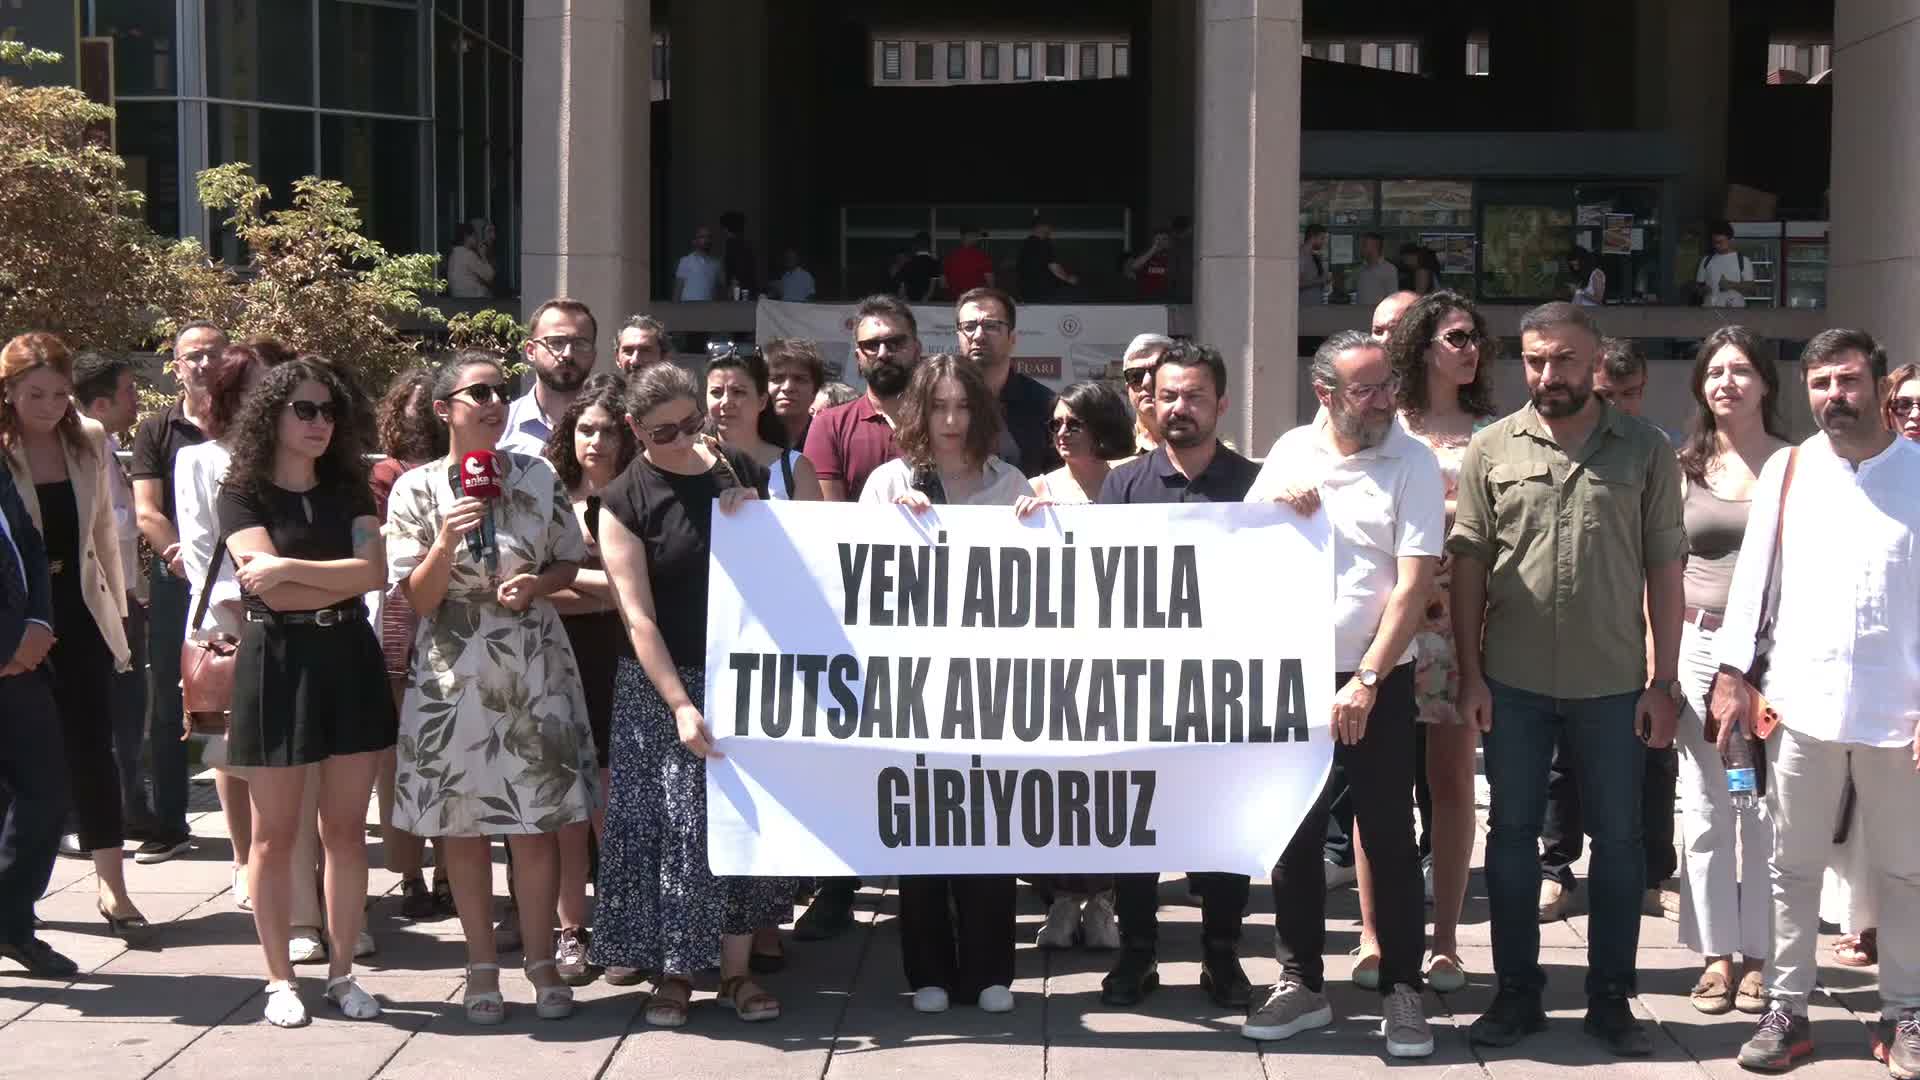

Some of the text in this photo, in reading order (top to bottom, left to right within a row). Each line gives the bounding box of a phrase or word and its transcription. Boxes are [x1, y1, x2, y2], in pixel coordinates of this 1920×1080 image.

[838, 530, 1202, 628] YENİ ADLİ YILA
[729, 653, 1309, 743] TUTSAK AVUKATLARLA
[877, 753, 1156, 849] GİRİYORUZ
